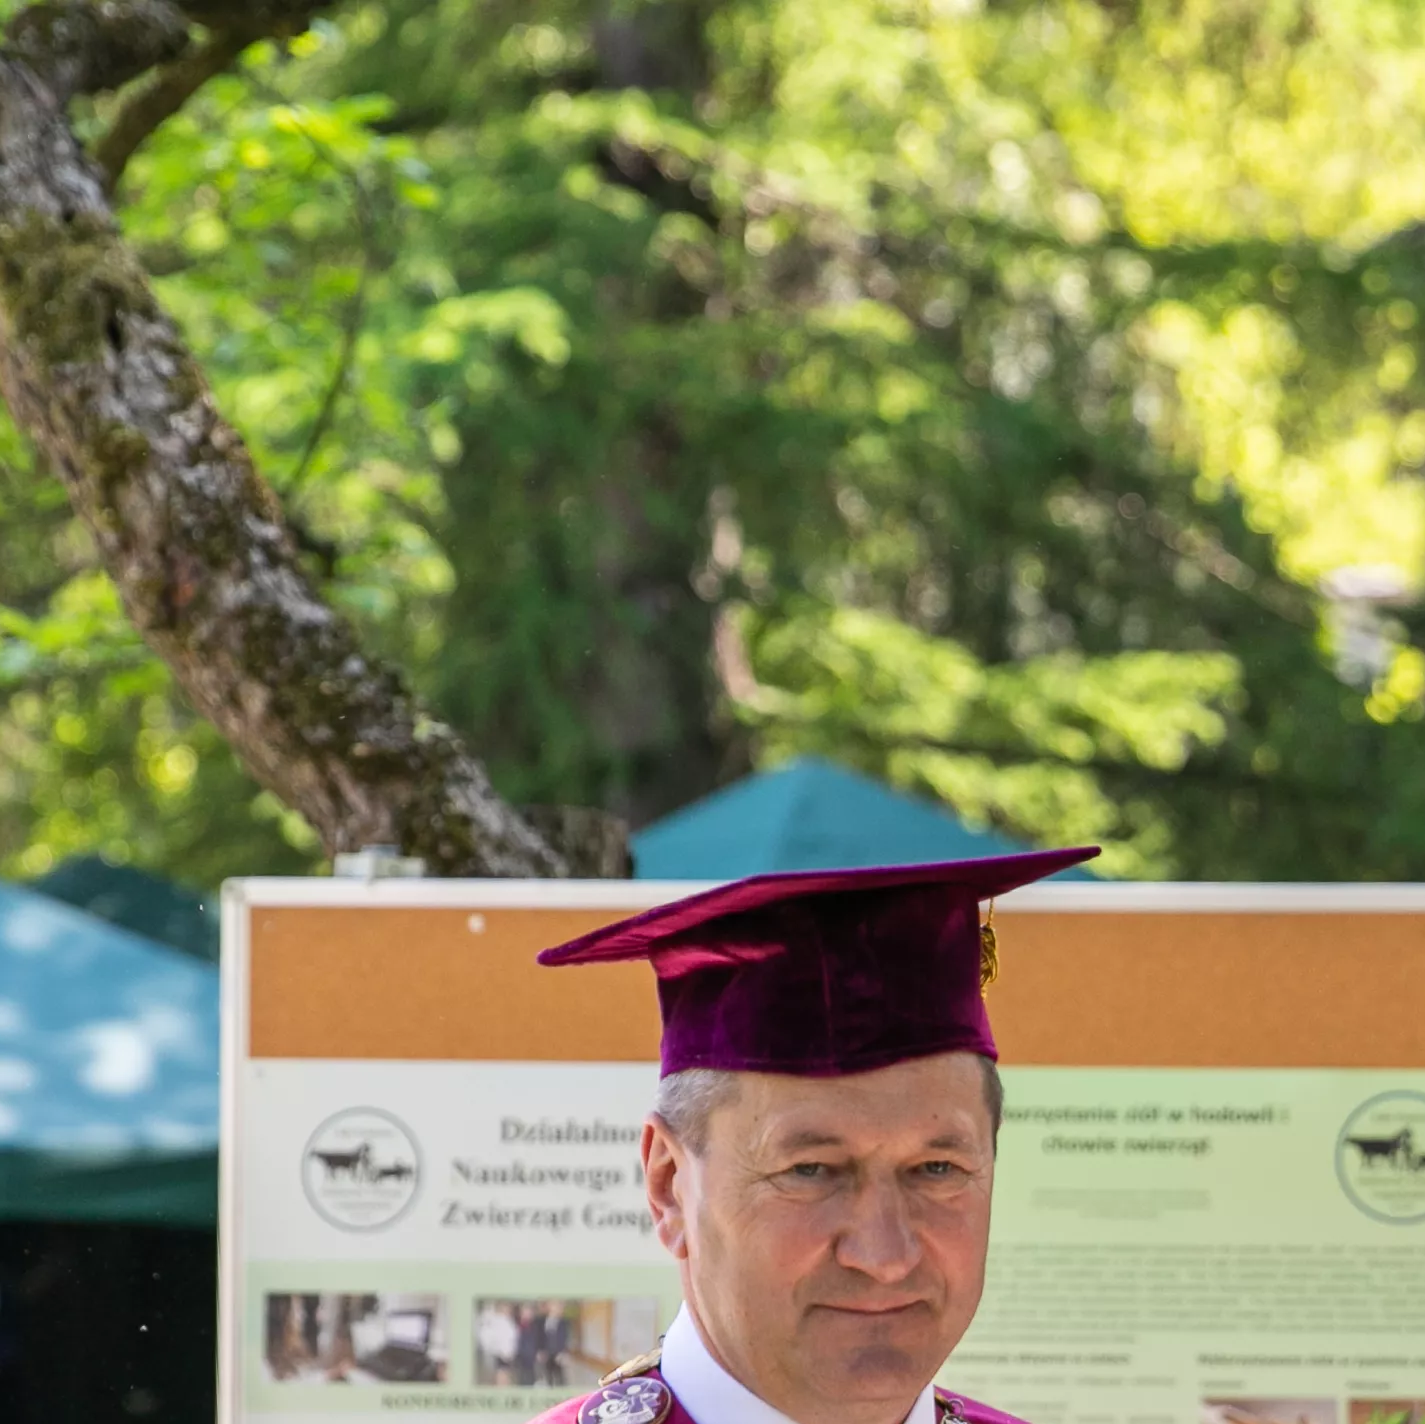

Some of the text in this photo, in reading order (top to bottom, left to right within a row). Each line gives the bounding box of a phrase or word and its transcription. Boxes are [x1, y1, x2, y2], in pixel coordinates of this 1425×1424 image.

[499, 1116, 643, 1145] Działalno
[452, 1159, 623, 1192] Naukowego
[439, 1203, 572, 1236] Zwierząt
